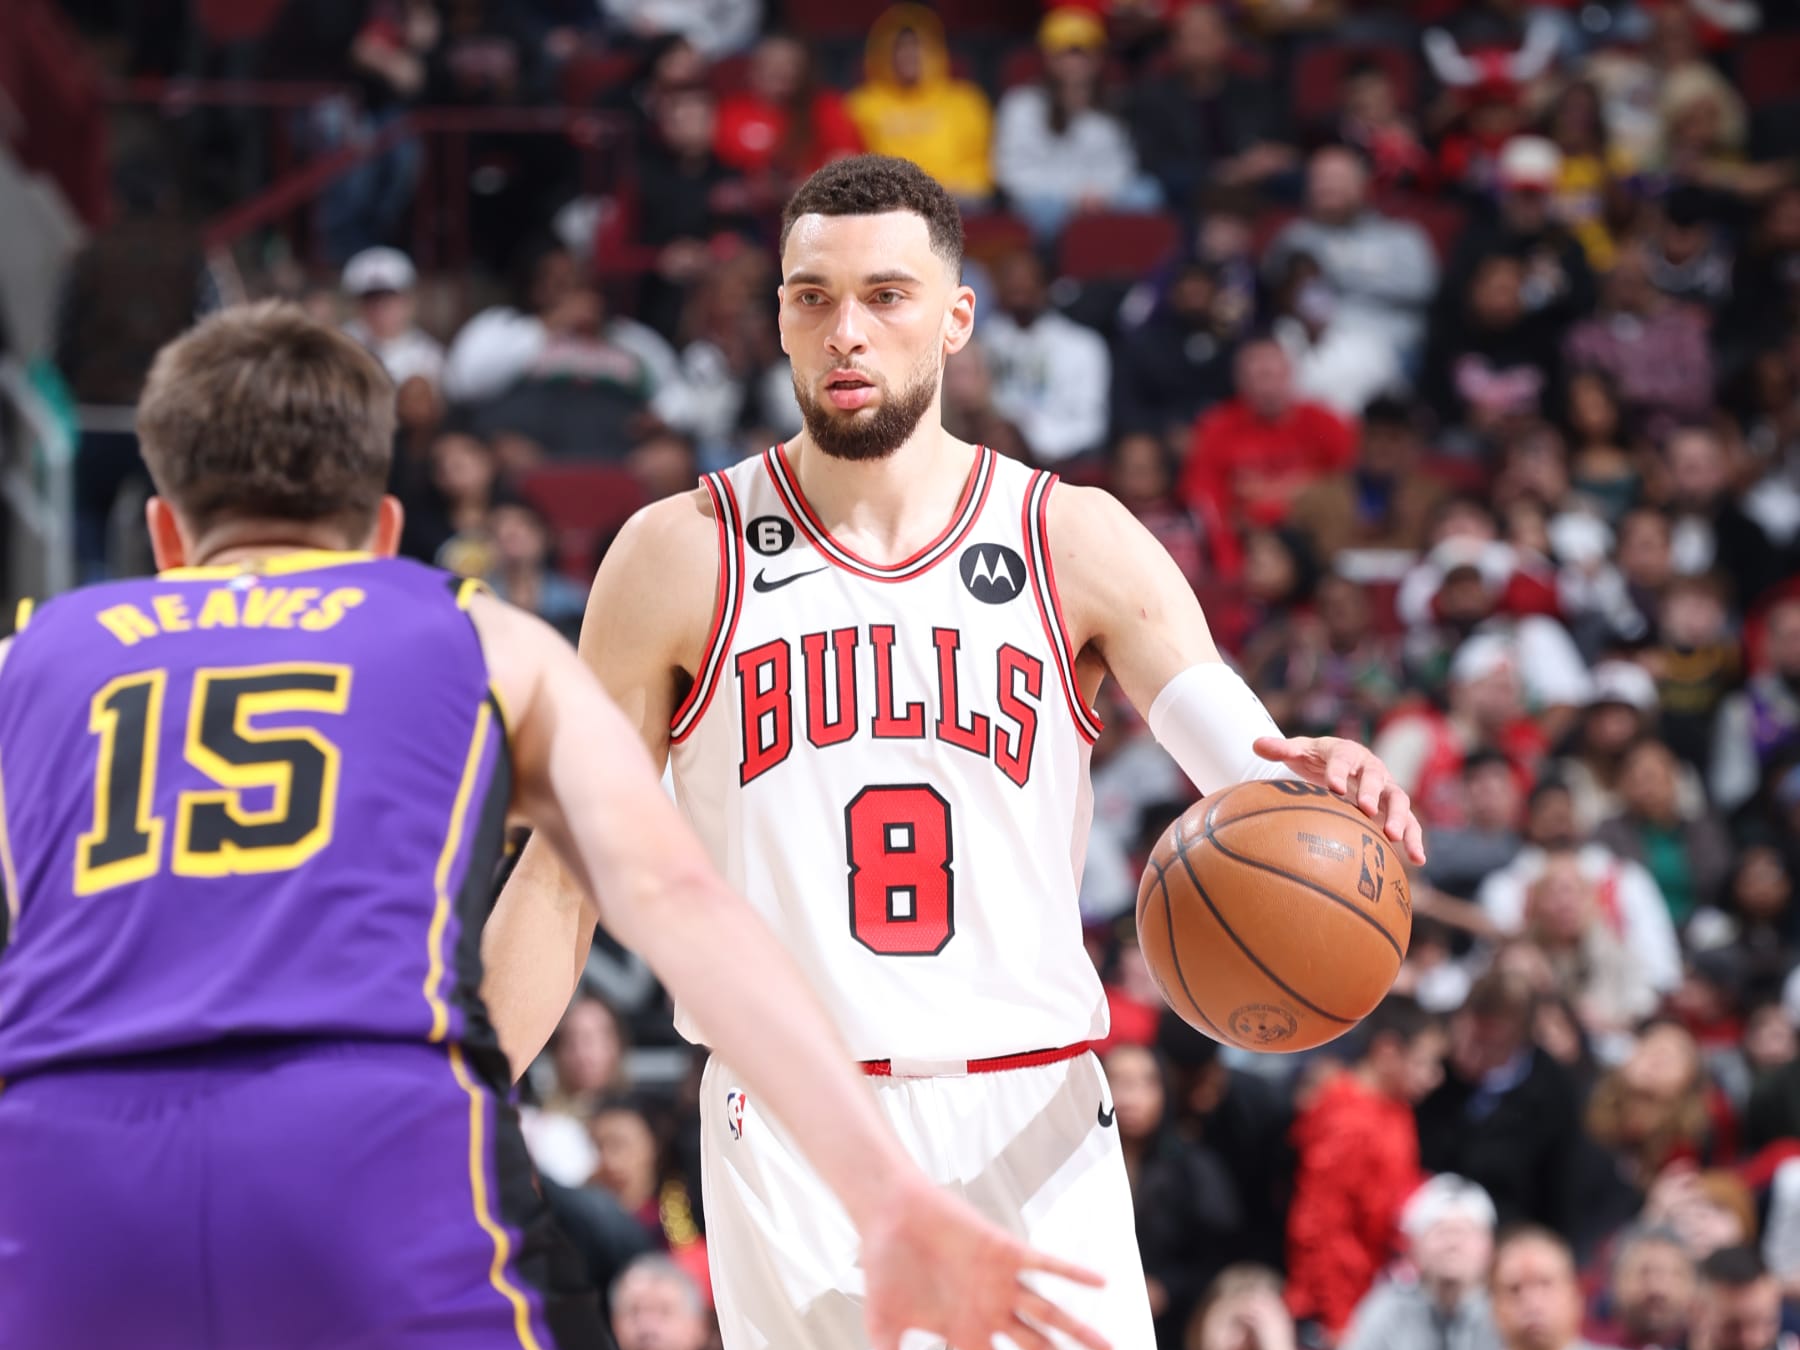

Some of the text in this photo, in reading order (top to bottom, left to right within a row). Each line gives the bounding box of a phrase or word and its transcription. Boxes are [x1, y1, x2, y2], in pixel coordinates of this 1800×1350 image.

[97, 587, 366, 646] REAVES
[757, 520, 783, 552] 6
[73, 661, 353, 896] 15
[735, 623, 1044, 788] BULLS
[844, 783, 955, 956] 8
